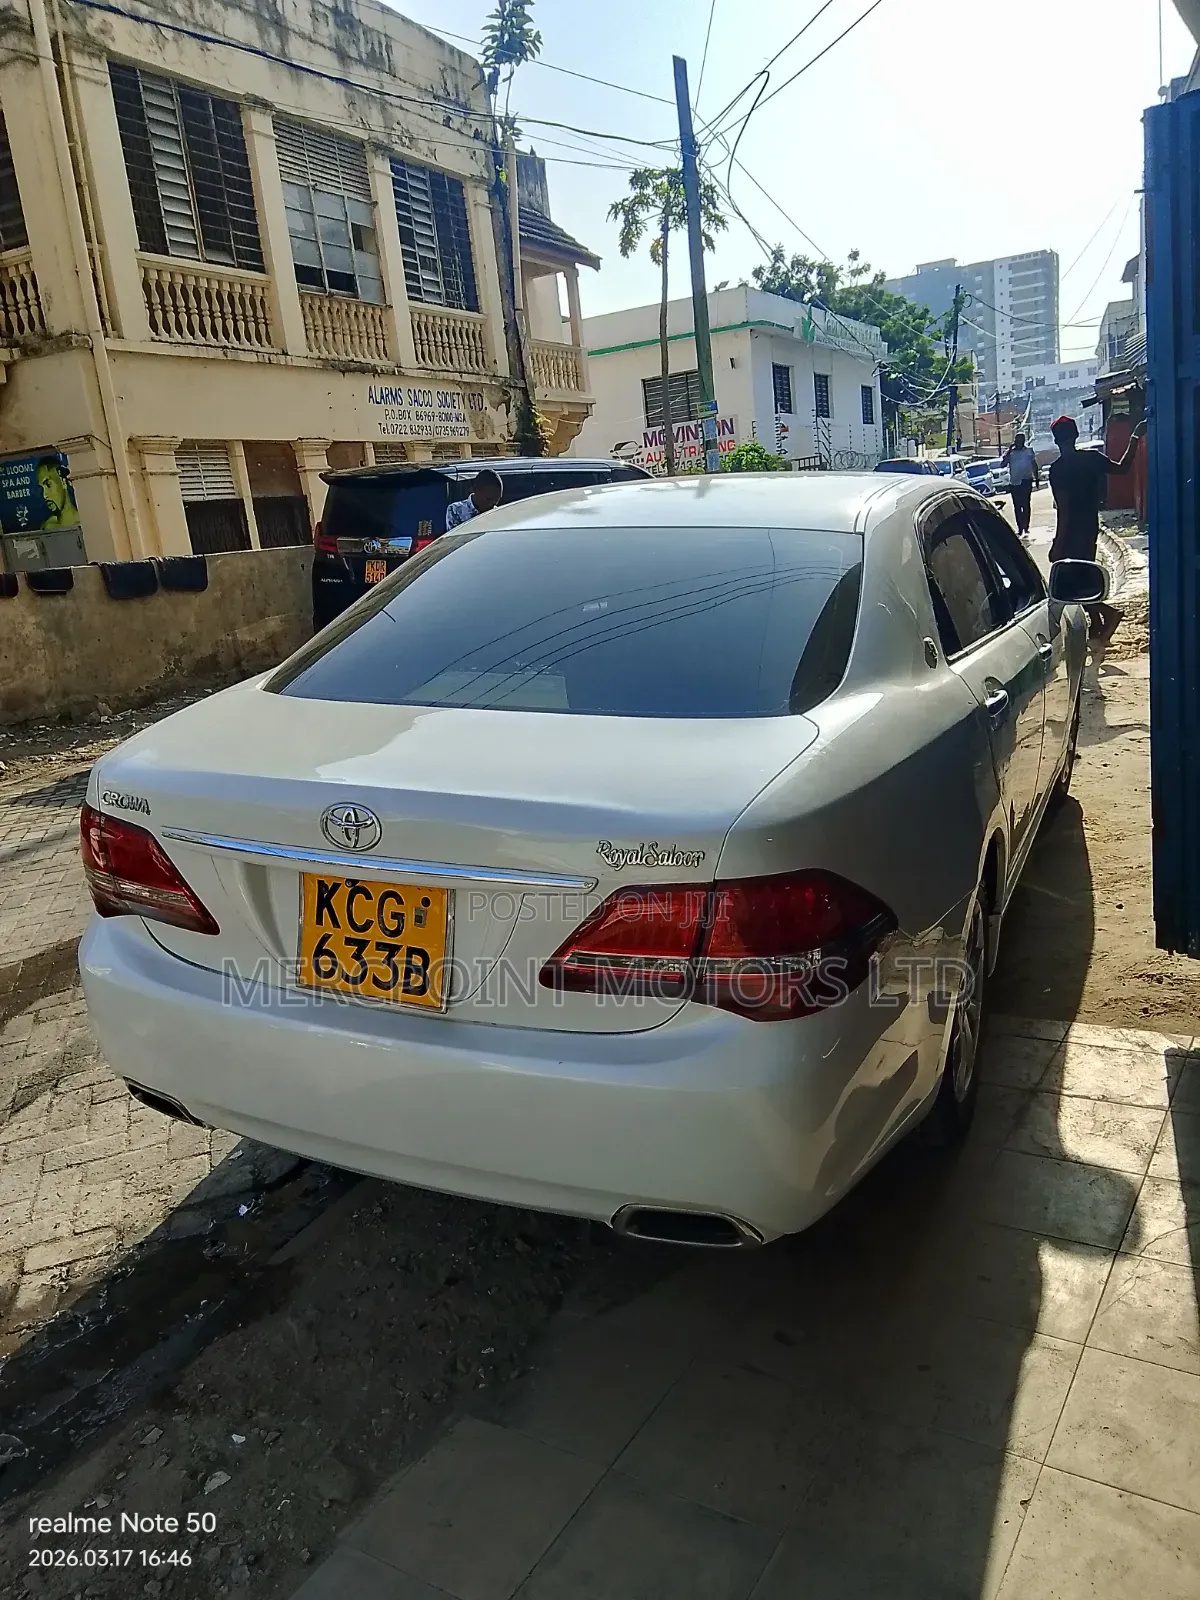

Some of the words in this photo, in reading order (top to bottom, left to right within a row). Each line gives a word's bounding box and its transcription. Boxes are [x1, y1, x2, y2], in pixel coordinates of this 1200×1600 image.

[368, 385, 403, 406] ALARMS
[407, 388, 433, 409] SACCO
[436, 390, 467, 410] SOCIETY
[468, 391, 488, 412] LTD.
[2, 478, 15, 488] SPA
[16, 476, 31, 486] AND
[6, 463, 35, 475] BLOOMZ
[6, 488, 31, 499] BARBER
[101, 789, 152, 816] CROWN
[596, 839, 644, 871] Royal
[642, 841, 706, 868] Saloon
[315, 879, 406, 938] KCG
[312, 932, 431, 997] 633B
